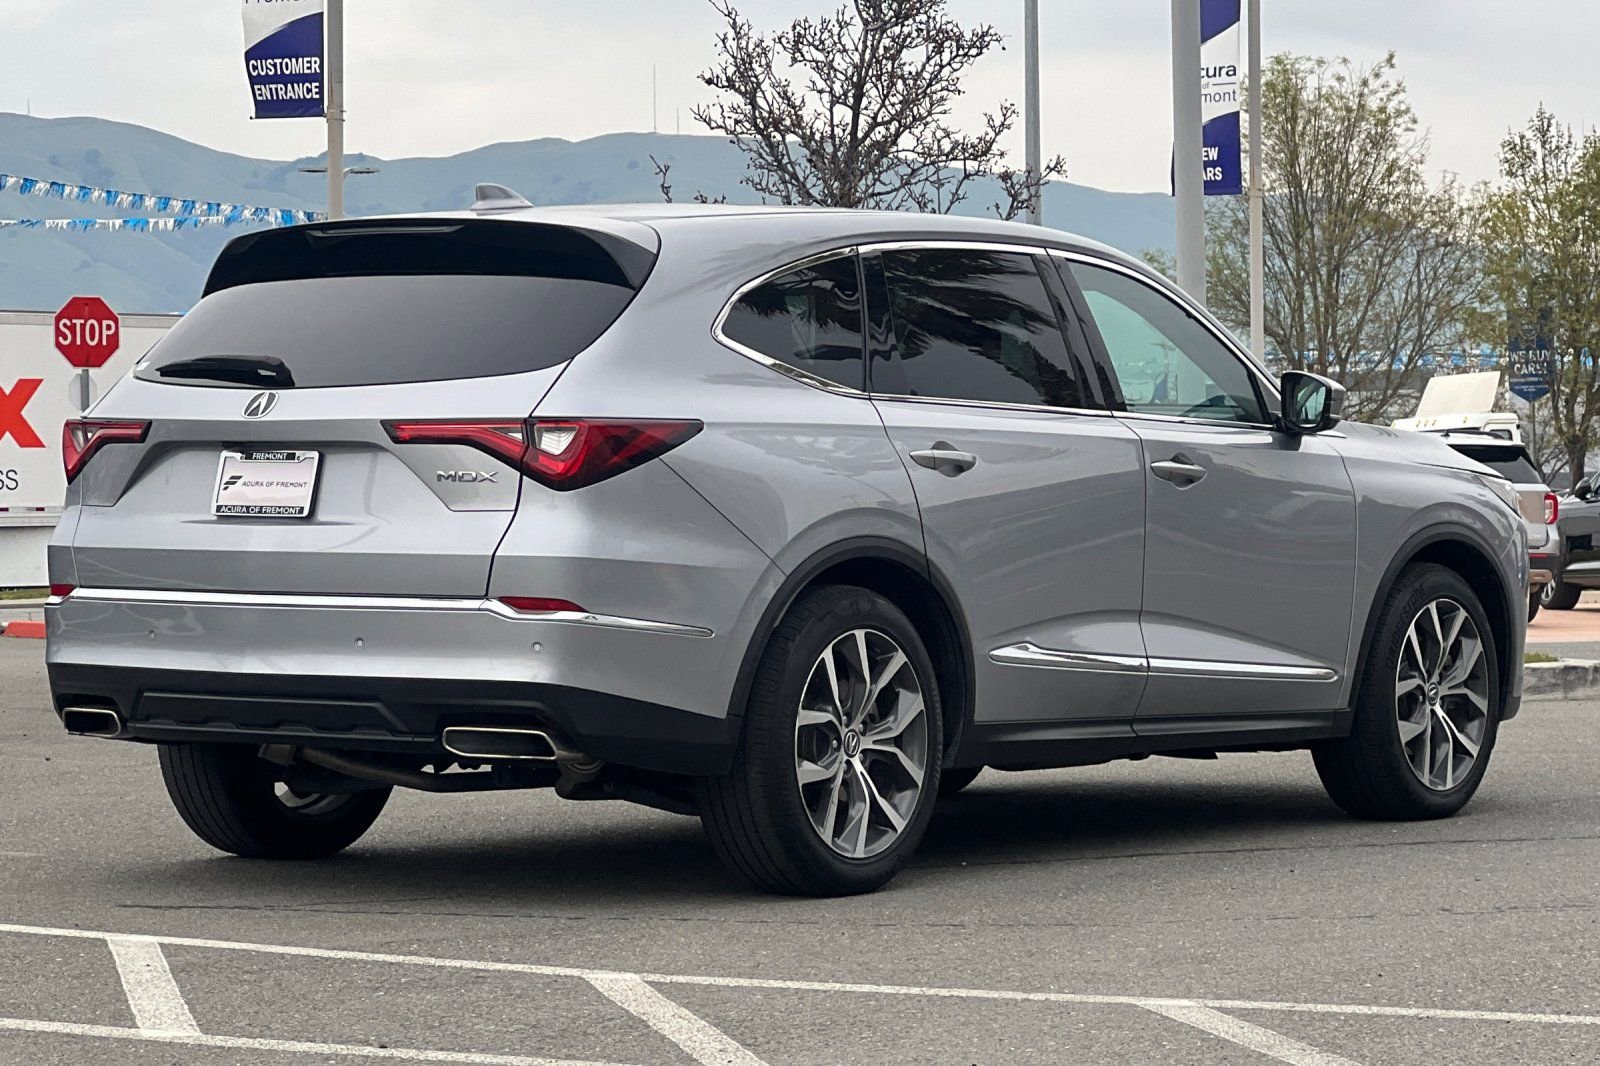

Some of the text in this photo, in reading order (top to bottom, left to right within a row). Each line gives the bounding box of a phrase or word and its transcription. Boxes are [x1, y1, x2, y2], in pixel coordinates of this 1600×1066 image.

[249, 56, 320, 76] CUSTOMER
[253, 82, 320, 101] ENTRANCE
[1202, 81, 1210, 90] of
[1201, 89, 1237, 103] mont
[1202, 146, 1219, 161] EW
[58, 318, 116, 346] STOP
[1510, 350, 1526, 362] WE
[252, 452, 287, 460] FREMONT
[436, 470, 498, 483] MDX
[242, 480, 308, 489] ACURA OF FREMONT
[220, 505, 301, 515] ACURA OF FREMONT
